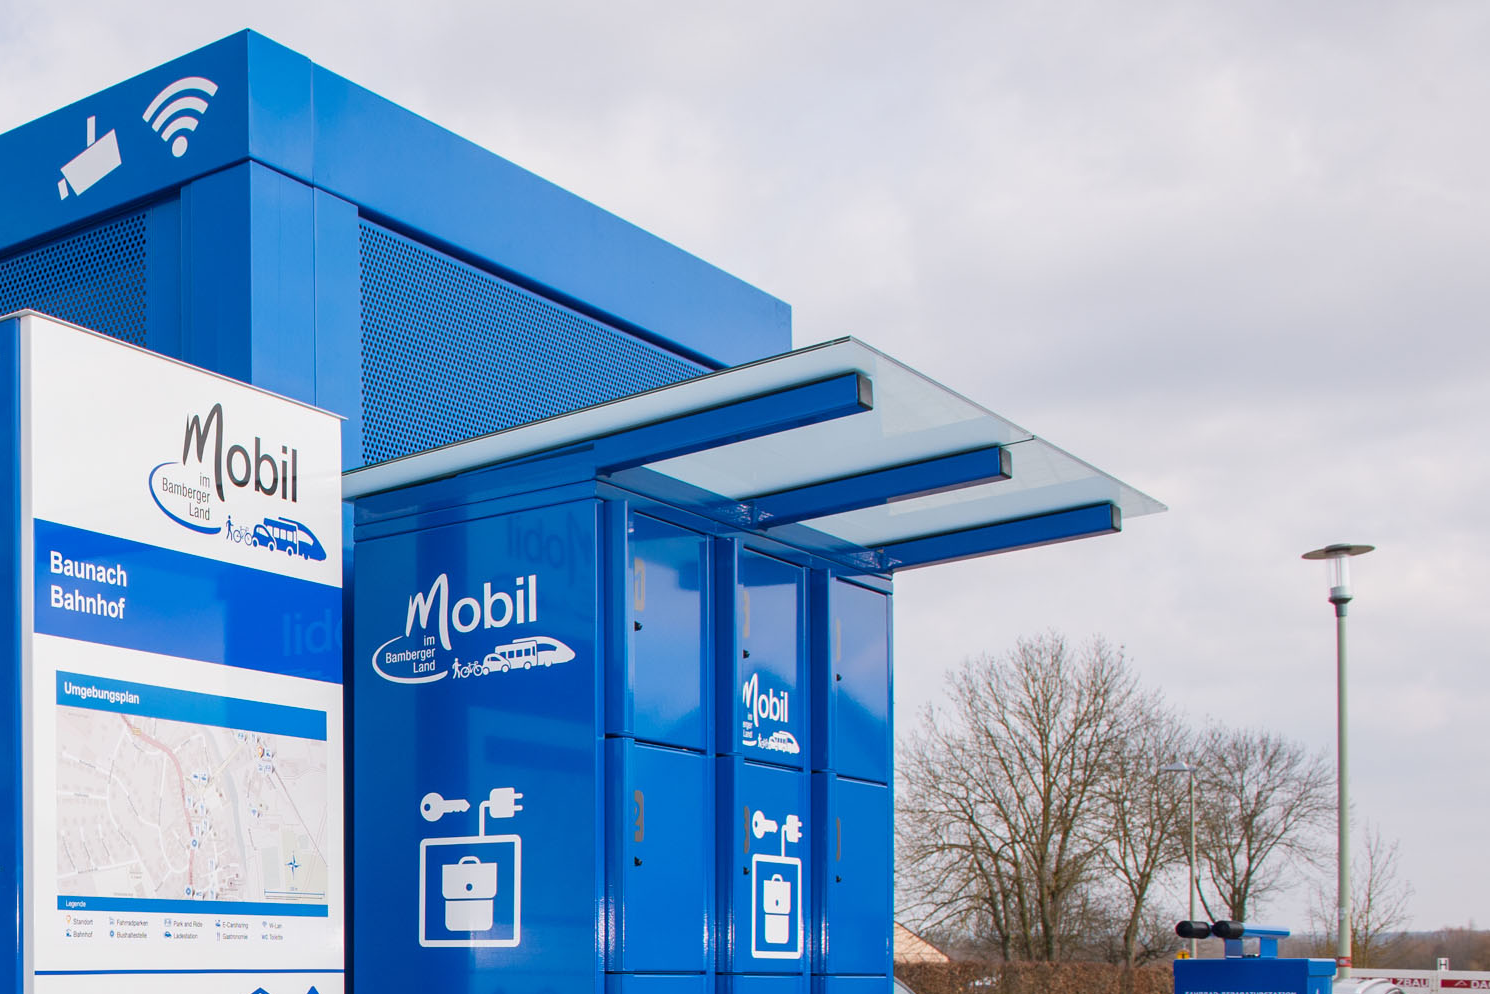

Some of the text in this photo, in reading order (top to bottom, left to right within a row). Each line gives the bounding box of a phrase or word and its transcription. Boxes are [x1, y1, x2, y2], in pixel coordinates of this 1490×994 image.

[183, 403, 298, 503] Mobil
[199, 472, 210, 488] im
[162, 477, 210, 504] Bamberger
[189, 502, 210, 521] Land
[50, 550, 127, 587] Baunach
[51, 584, 125, 619] Bahnhof
[405, 573, 537, 650] Mobil
[424, 634, 435, 646] im
[385, 648, 435, 664] Bamberger
[413, 661, 435, 673] Land
[64, 682, 140, 704] Umgebungsplan
[742, 672, 788, 727] Mobil
[65, 900, 86, 909] Legende
[73, 918, 93, 926] Standort
[116, 919, 148, 927] Fahrradparken
[73, 930, 93, 938] Bahnhof
